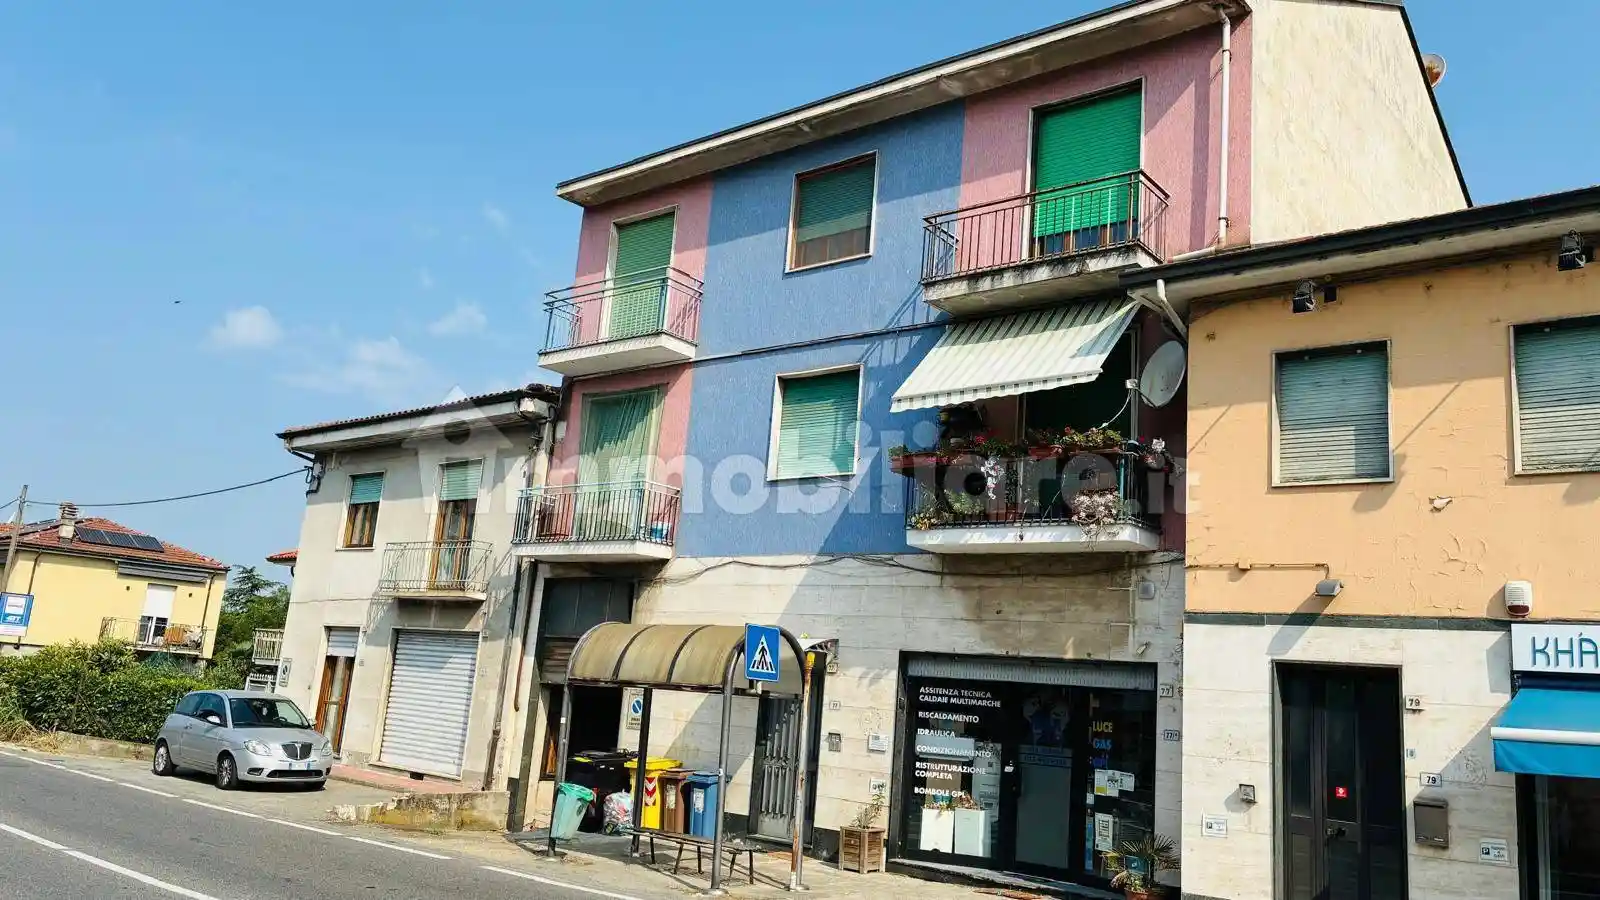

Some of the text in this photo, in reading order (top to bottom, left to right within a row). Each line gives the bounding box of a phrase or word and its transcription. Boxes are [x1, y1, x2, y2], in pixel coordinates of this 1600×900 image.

[919, 686, 992, 698] ASSITENZA TECNICA
[919, 695, 1001, 708] CALDAIE MULTIMARCHE
[1408, 698, 1421, 707] 79
[918, 711, 980, 723] RISCALDAMENTO
[917, 728, 956, 737] IDRAULICA
[1092, 720, 1113, 733] LUCE
[1092, 738, 1112, 750] GAS
[916, 745, 991, 758] CONDIZIONAMENTO
[915, 761, 987, 775] RISTRUTTURAZIONE
[914, 770, 953, 780] COMPLETA
[1426, 775, 1437, 784] 79
[914, 786, 950, 797] BOMBOLE
